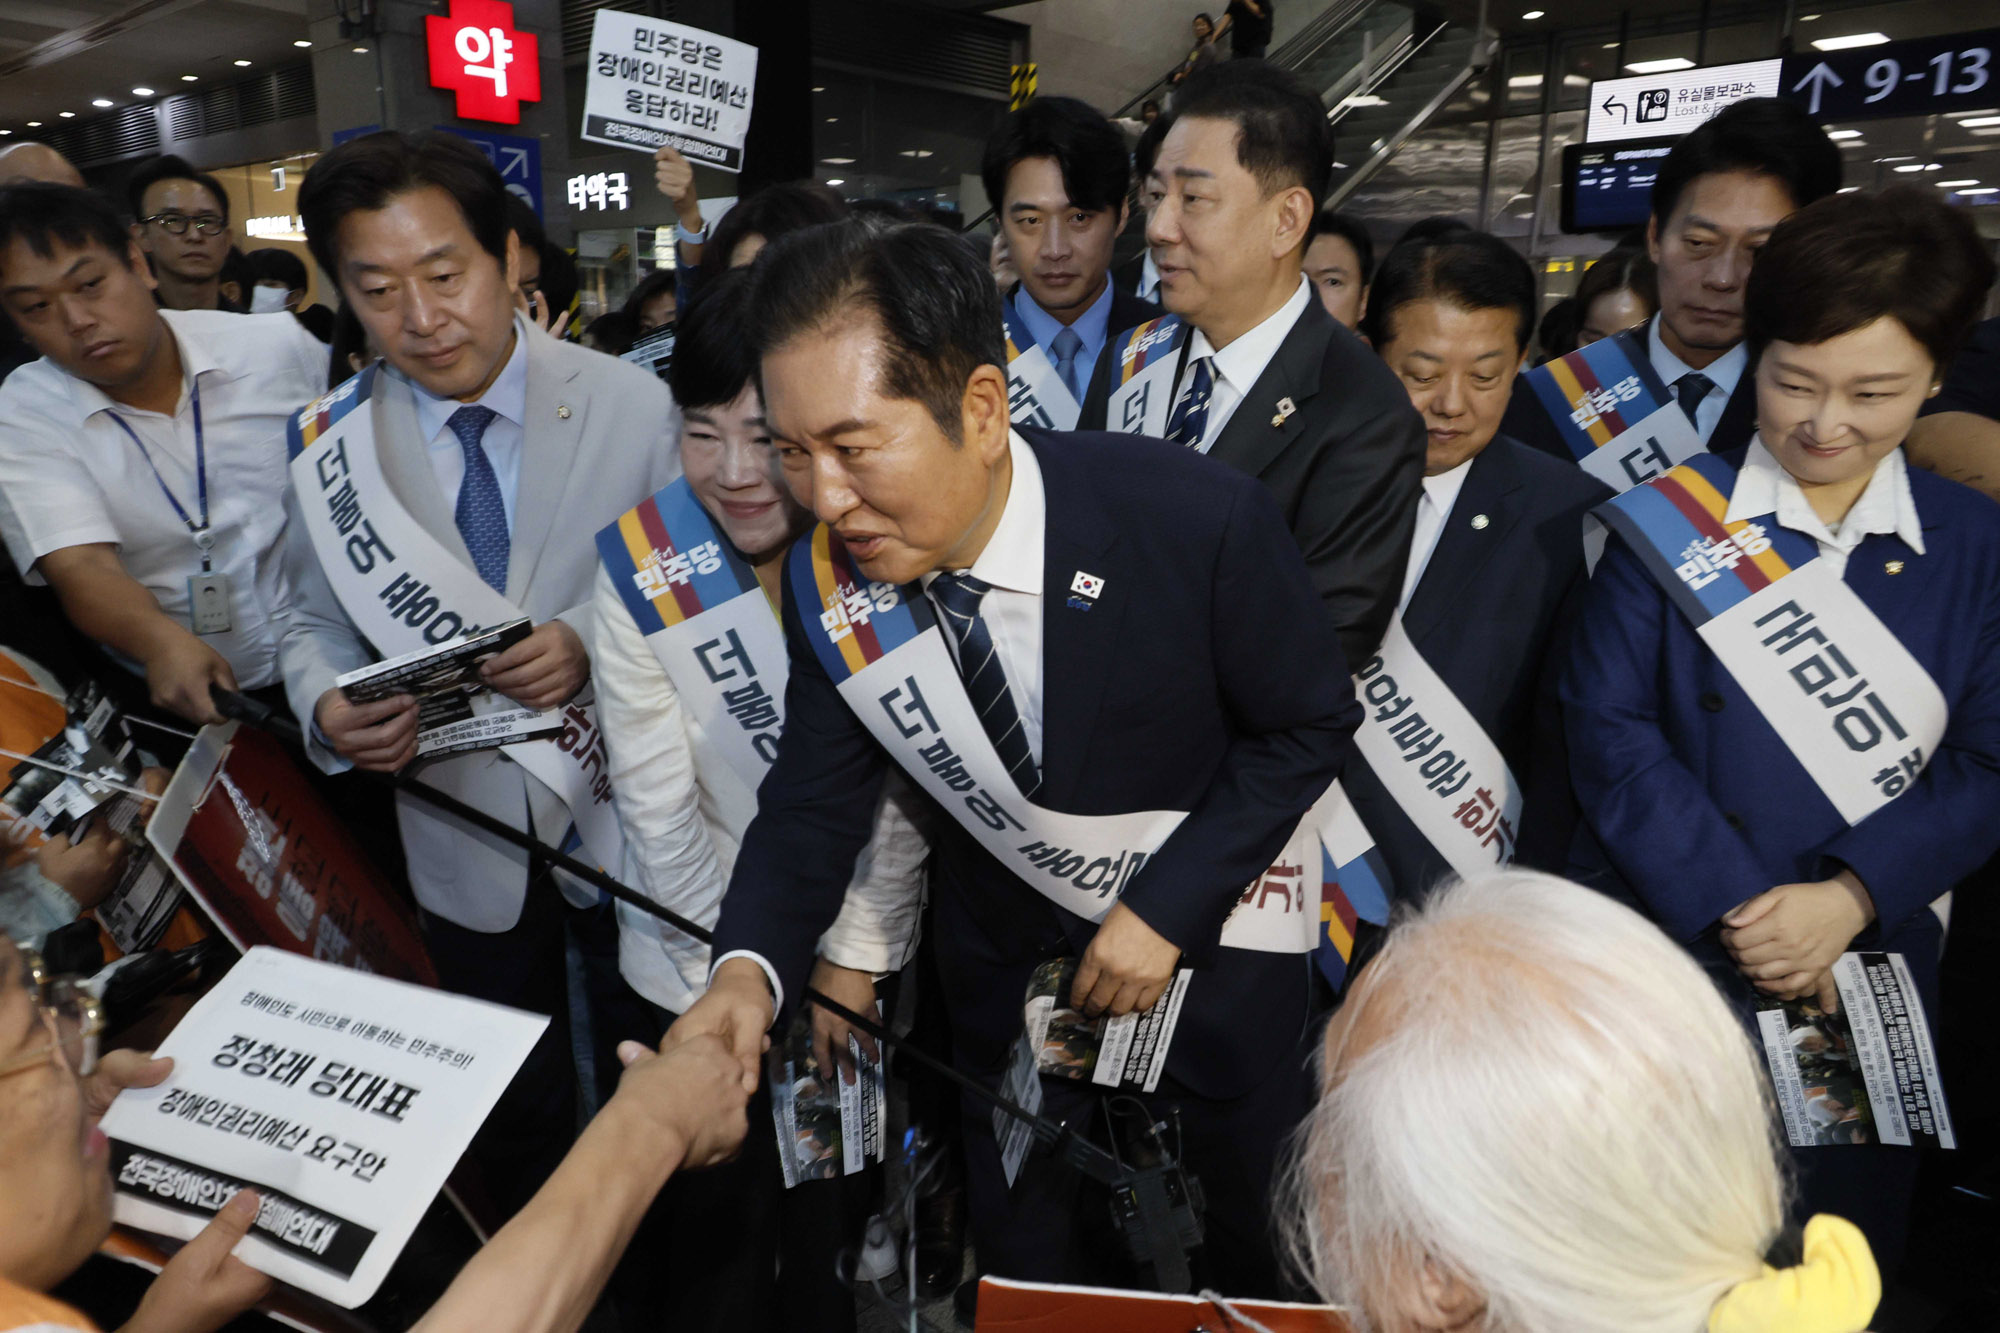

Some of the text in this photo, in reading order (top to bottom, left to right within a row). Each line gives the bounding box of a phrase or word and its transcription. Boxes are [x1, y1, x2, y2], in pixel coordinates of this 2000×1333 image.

[454, 26, 514, 97] 약
[633, 27, 723, 71] 민주당은
[1863, 47, 1992, 105] 9-13
[597, 51, 748, 110] 장애인권리예산
[625, 88, 720, 132] 응답하라!
[1678, 81, 1756, 103] 유실물보관소
[1675, 104, 1699, 117] Lost
[566, 172, 630, 212] 타약국
[1120, 322, 1180, 367] 민주당
[1569, 375, 1642, 431] 민주당
[632, 540, 722, 601] 민주당
[1675, 523, 1772, 591] 민주당
[377, 571, 481, 646] 풍요
[819, 581, 899, 644] 민주당
[1753, 599, 1909, 752] 국민이
[484, 723, 512, 736] 24년간
[492, 713, 515, 725] 장애인
[878, 674, 1027, 832] 더불어
[1017, 840, 1146, 899] 풍요
[1356, 655, 1514, 867] 요로운 한가
[240, 990, 474, 1071] 장애인도 시민으로 이동하는 민주주의!
[1866, 966, 1920, 1130] 이번 정기 국회에서 논의되는 2026년 예산안에
[210, 1033, 421, 1123] 정청래 당대표
[1868, 1080, 1882, 1104] 2024년
[1885, 1096, 1899, 1115] 권리를
[1913, 1084, 1928, 1107] 정부가
[157, 1087, 388, 1183] 장애인권리예산 요구안
[117, 1151, 342, 1256] 전국장애인철폐연대
